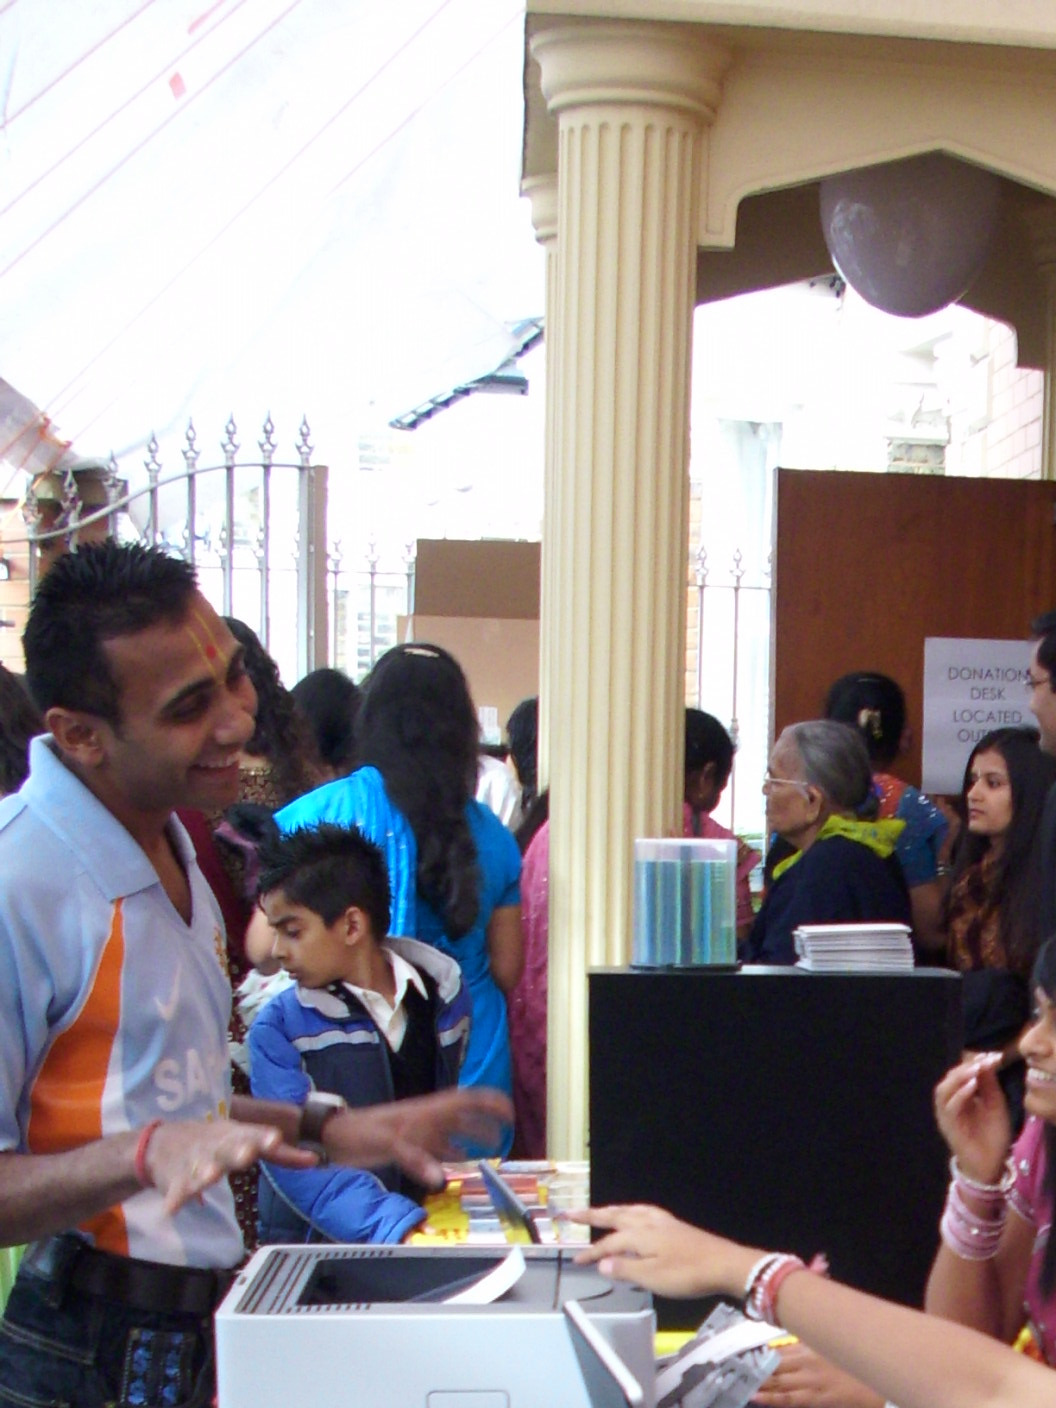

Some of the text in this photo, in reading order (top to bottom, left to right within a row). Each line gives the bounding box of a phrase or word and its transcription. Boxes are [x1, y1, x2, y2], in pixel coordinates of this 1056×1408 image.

[947, 667, 1029, 682] DONATION
[970, 687, 1006, 701] DESK
[952, 709, 1023, 724] LOCATED
